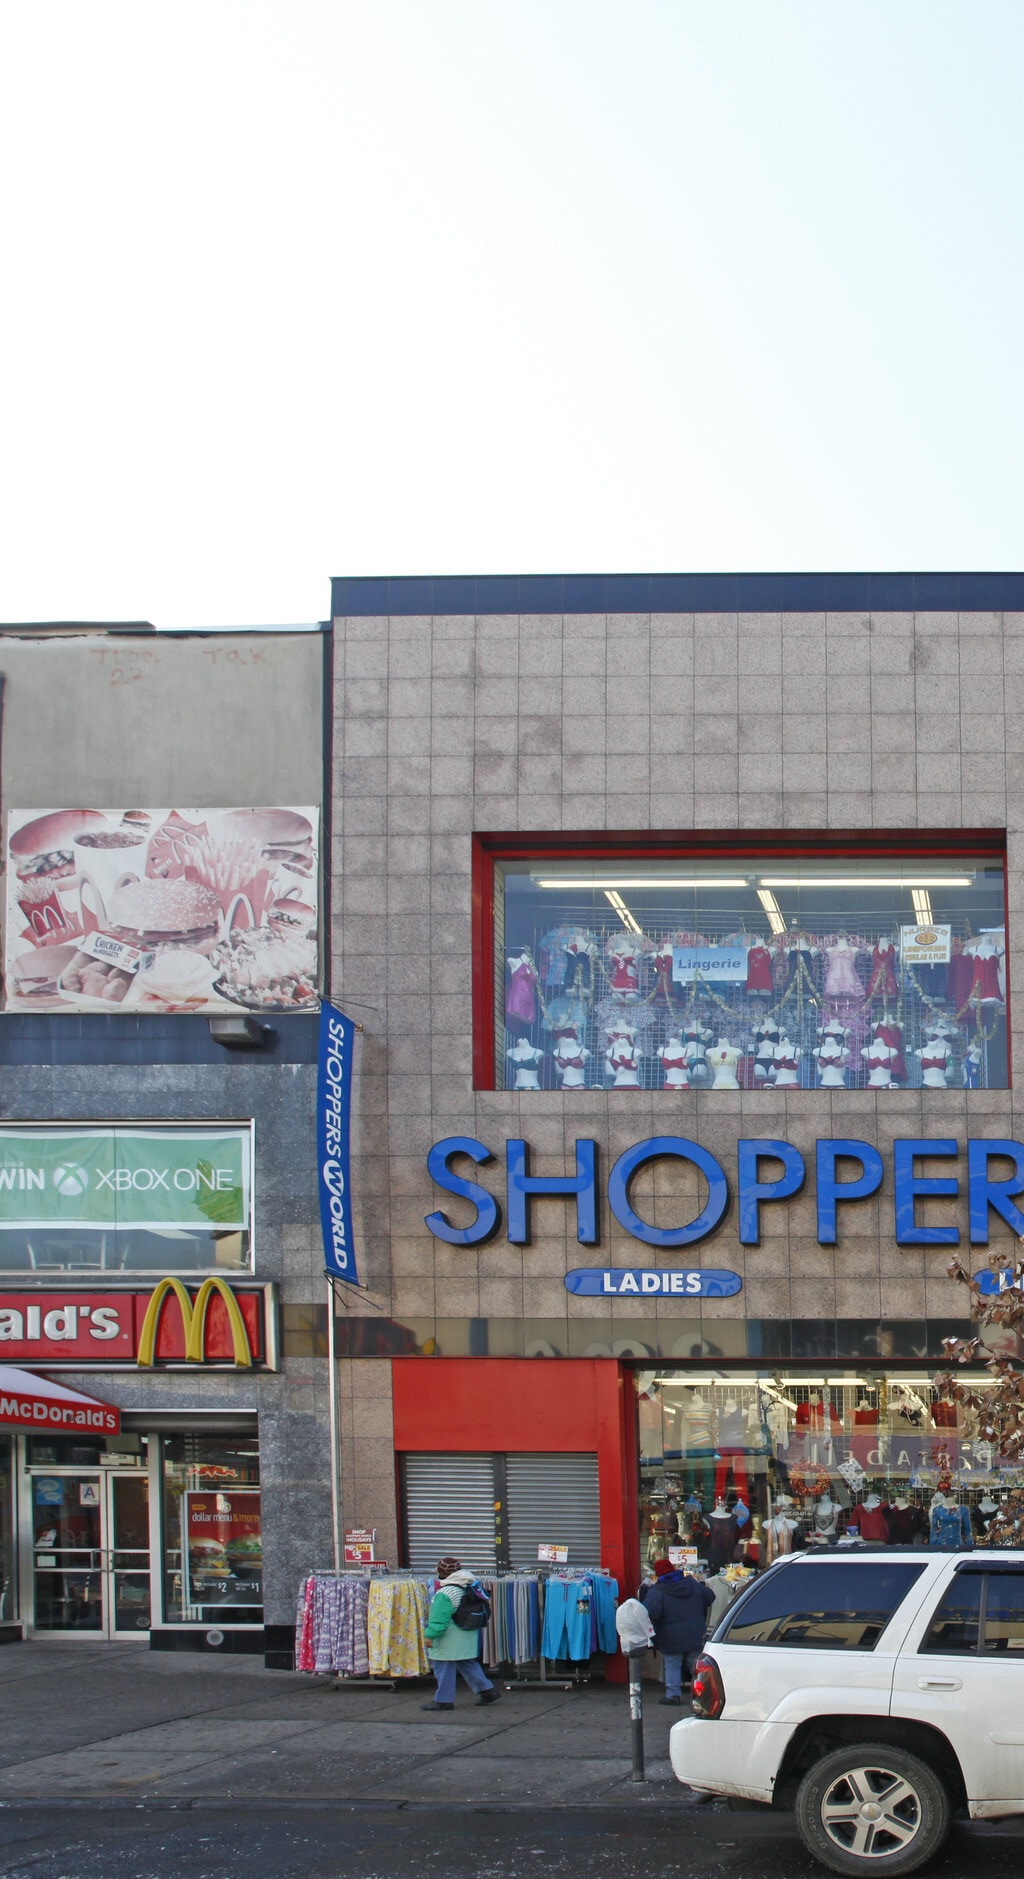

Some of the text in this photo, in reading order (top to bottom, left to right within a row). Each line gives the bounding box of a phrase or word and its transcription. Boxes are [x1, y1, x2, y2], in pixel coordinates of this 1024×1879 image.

[678, 958, 741, 971] Lingerie
[323, 1018, 348, 1270] SHOPPERS WORLD
[95, 1168, 234, 1191] XBOX ONE
[602, 1271, 702, 1293] LADIES
[0, 1398, 116, 1428] McDonald's
[84, 1487, 96, 1499] A
[192, 1512, 212, 1522] dollar
[213, 1513, 233, 1522] menu
[239, 1514, 259, 1522] more
[352, 1551, 362, 1560] $5
[547, 1551, 557, 1561] $4
[677, 1554, 688, 1564] $5
[217, 1582, 227, 1593] $2
[251, 1582, 260, 1593] $1
